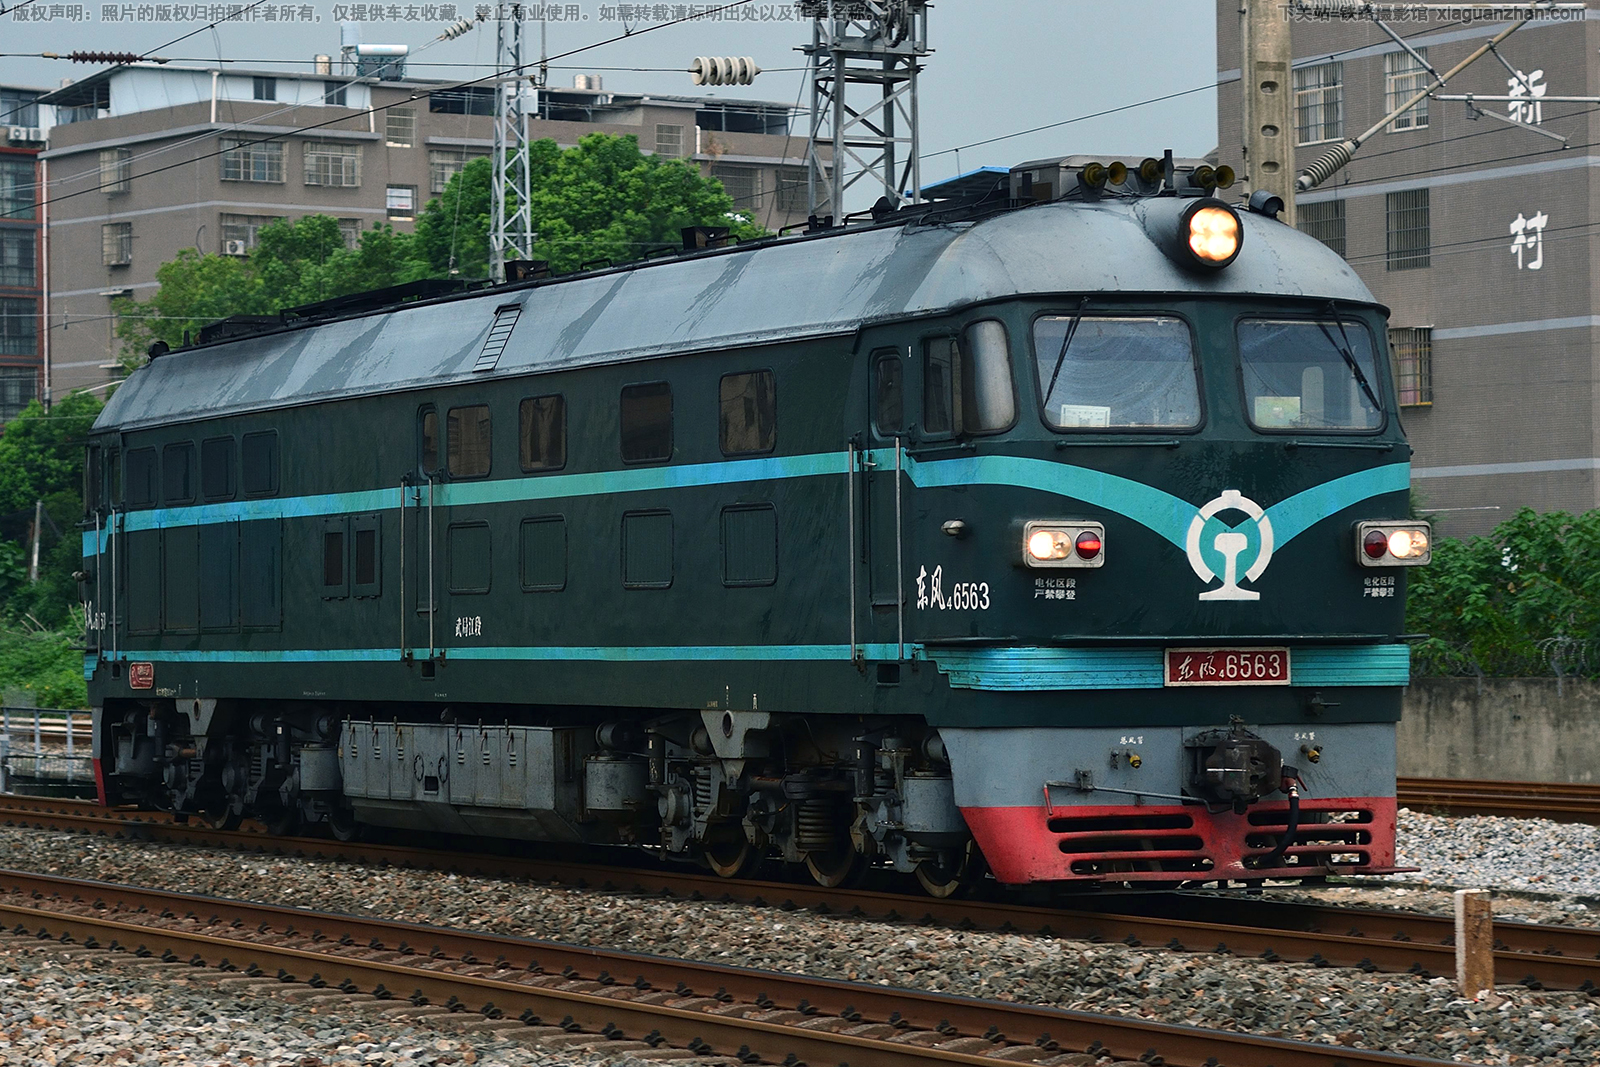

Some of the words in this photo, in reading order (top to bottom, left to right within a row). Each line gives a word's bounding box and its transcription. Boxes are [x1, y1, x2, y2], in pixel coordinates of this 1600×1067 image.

[1034, 577, 1077, 588] 电化区段
[1033, 588, 1077, 600] 严禁攀登
